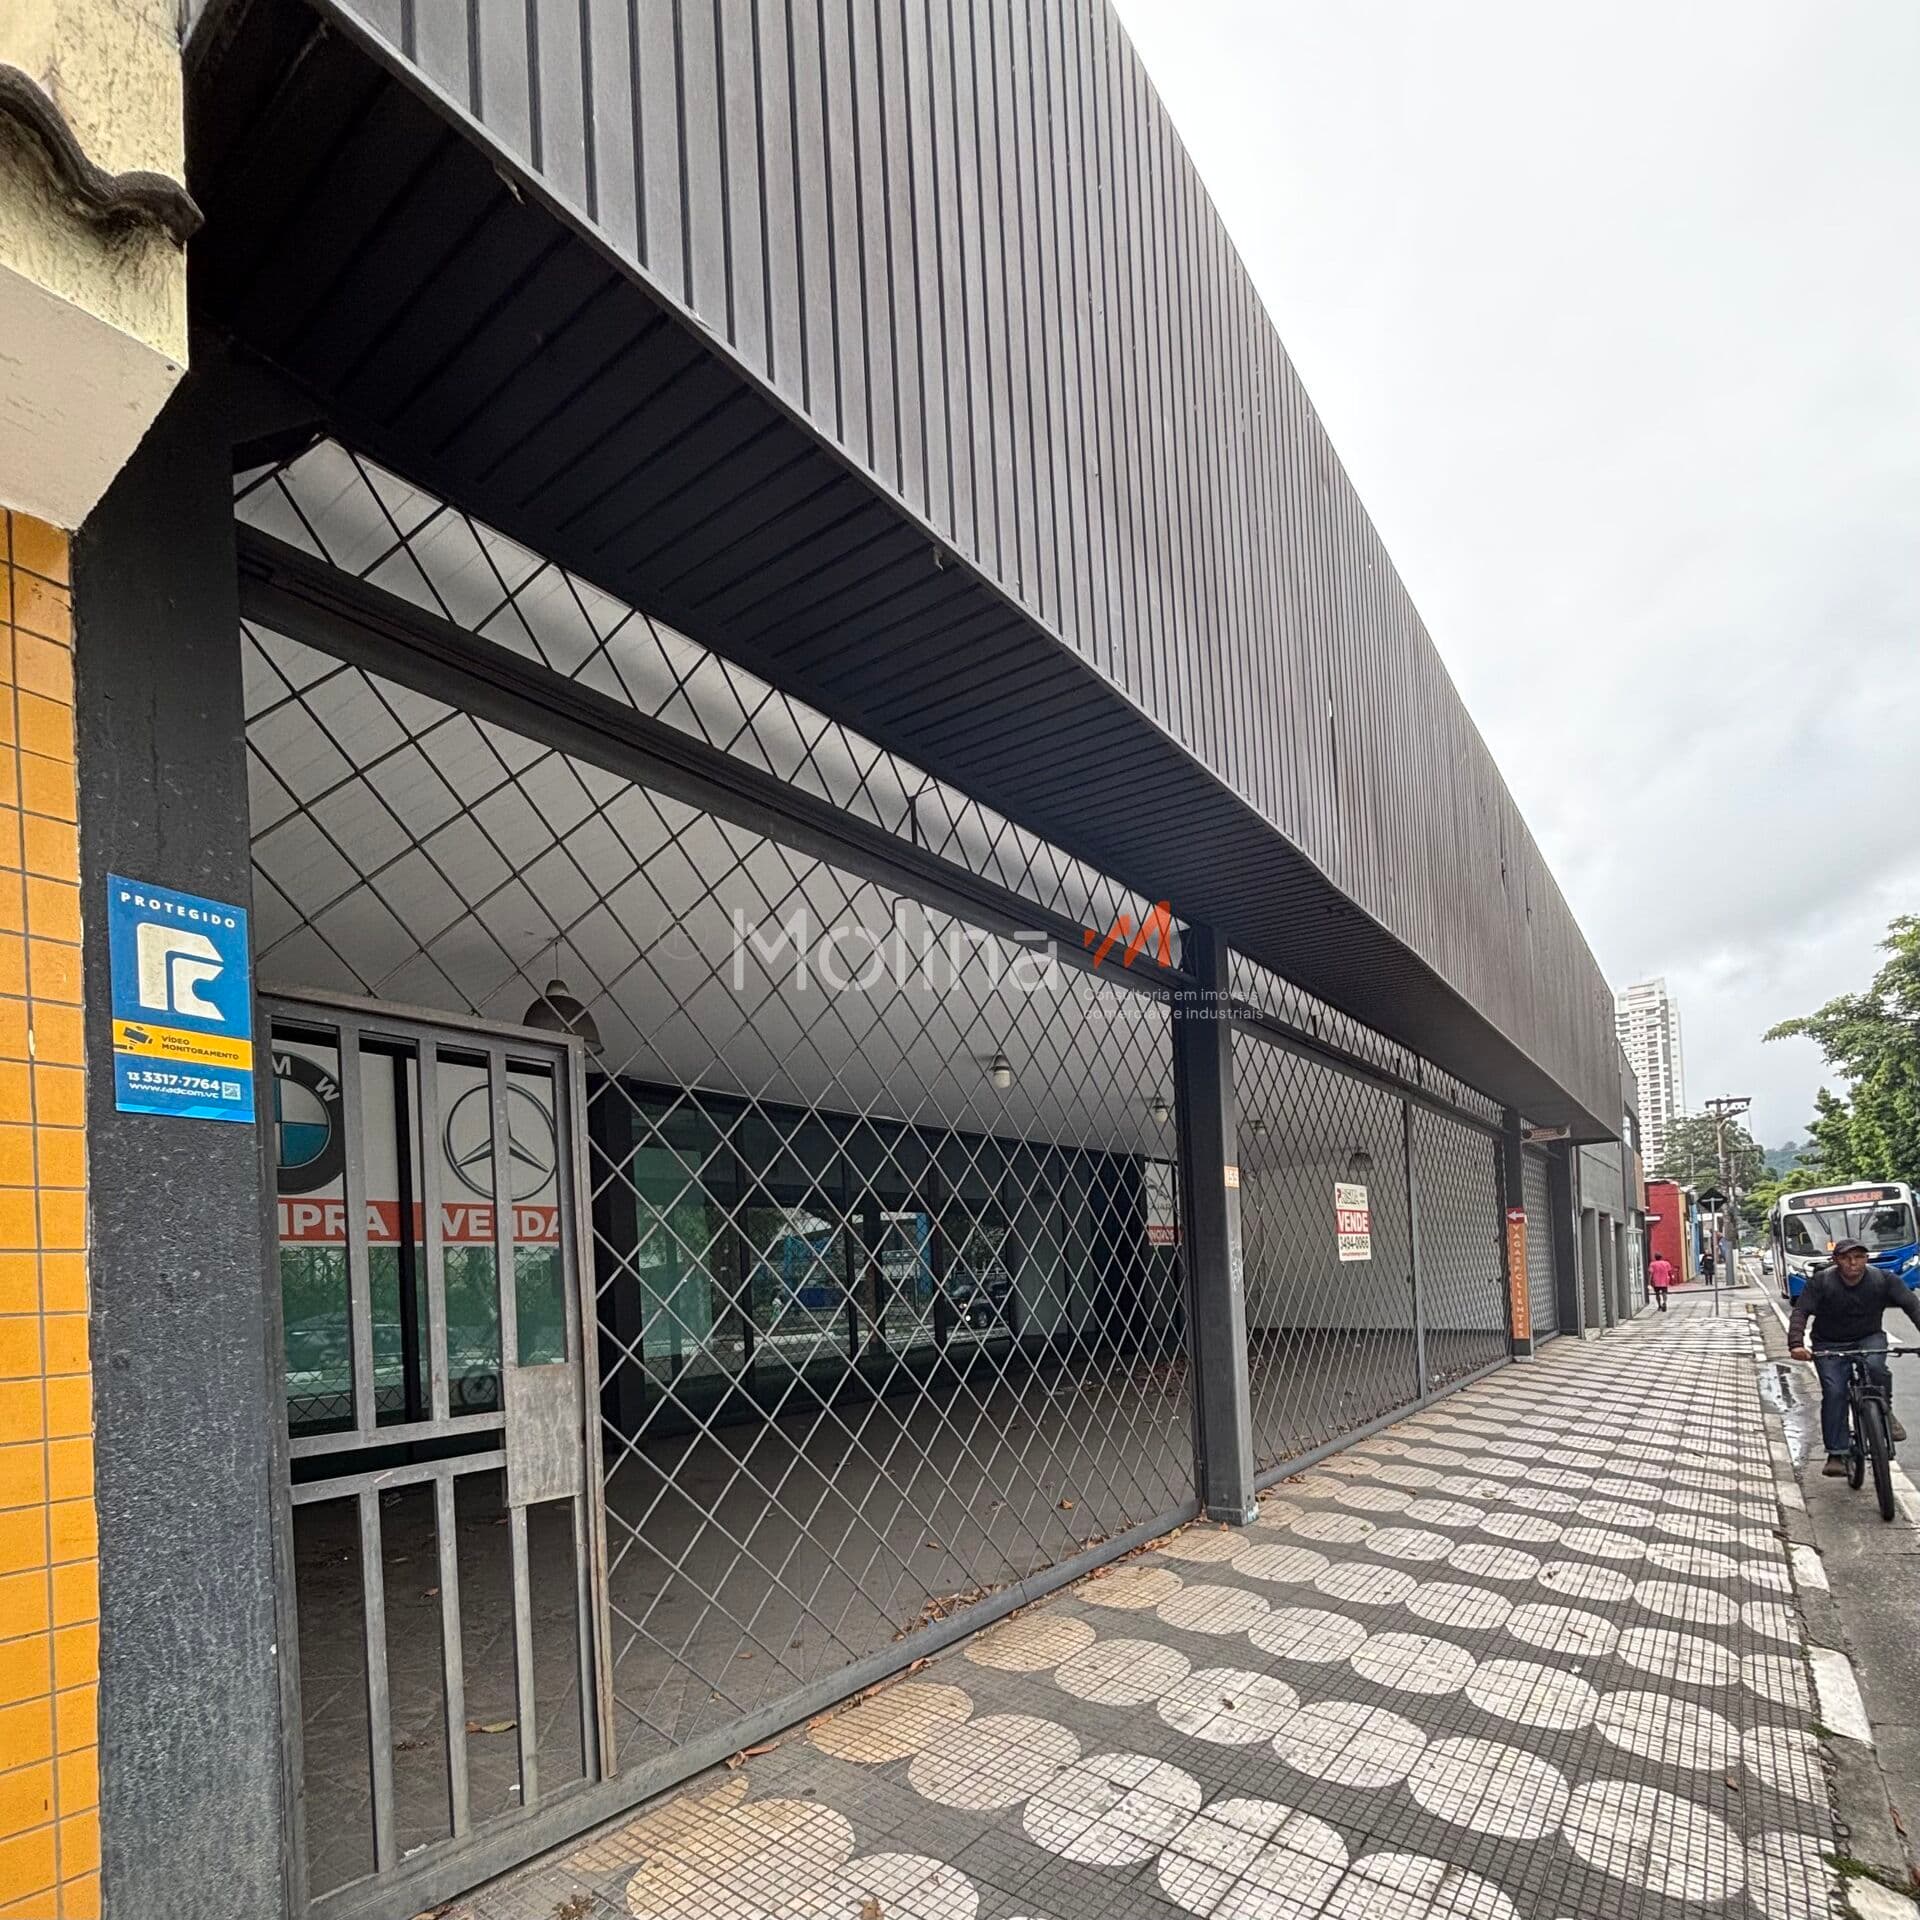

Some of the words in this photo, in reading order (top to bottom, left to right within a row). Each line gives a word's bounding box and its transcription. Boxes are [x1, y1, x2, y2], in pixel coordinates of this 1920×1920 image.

[120, 891, 237, 928] PROTEGIDO
[161, 1034, 190, 1046] VÍDEO
[161, 1044, 240, 1061] MONITORAMENTO
[127, 1071, 140, 1082] 13
[128, 1082, 219, 1099] www.radcom.vc
[1337, 1210, 1369, 1232] VENDE
